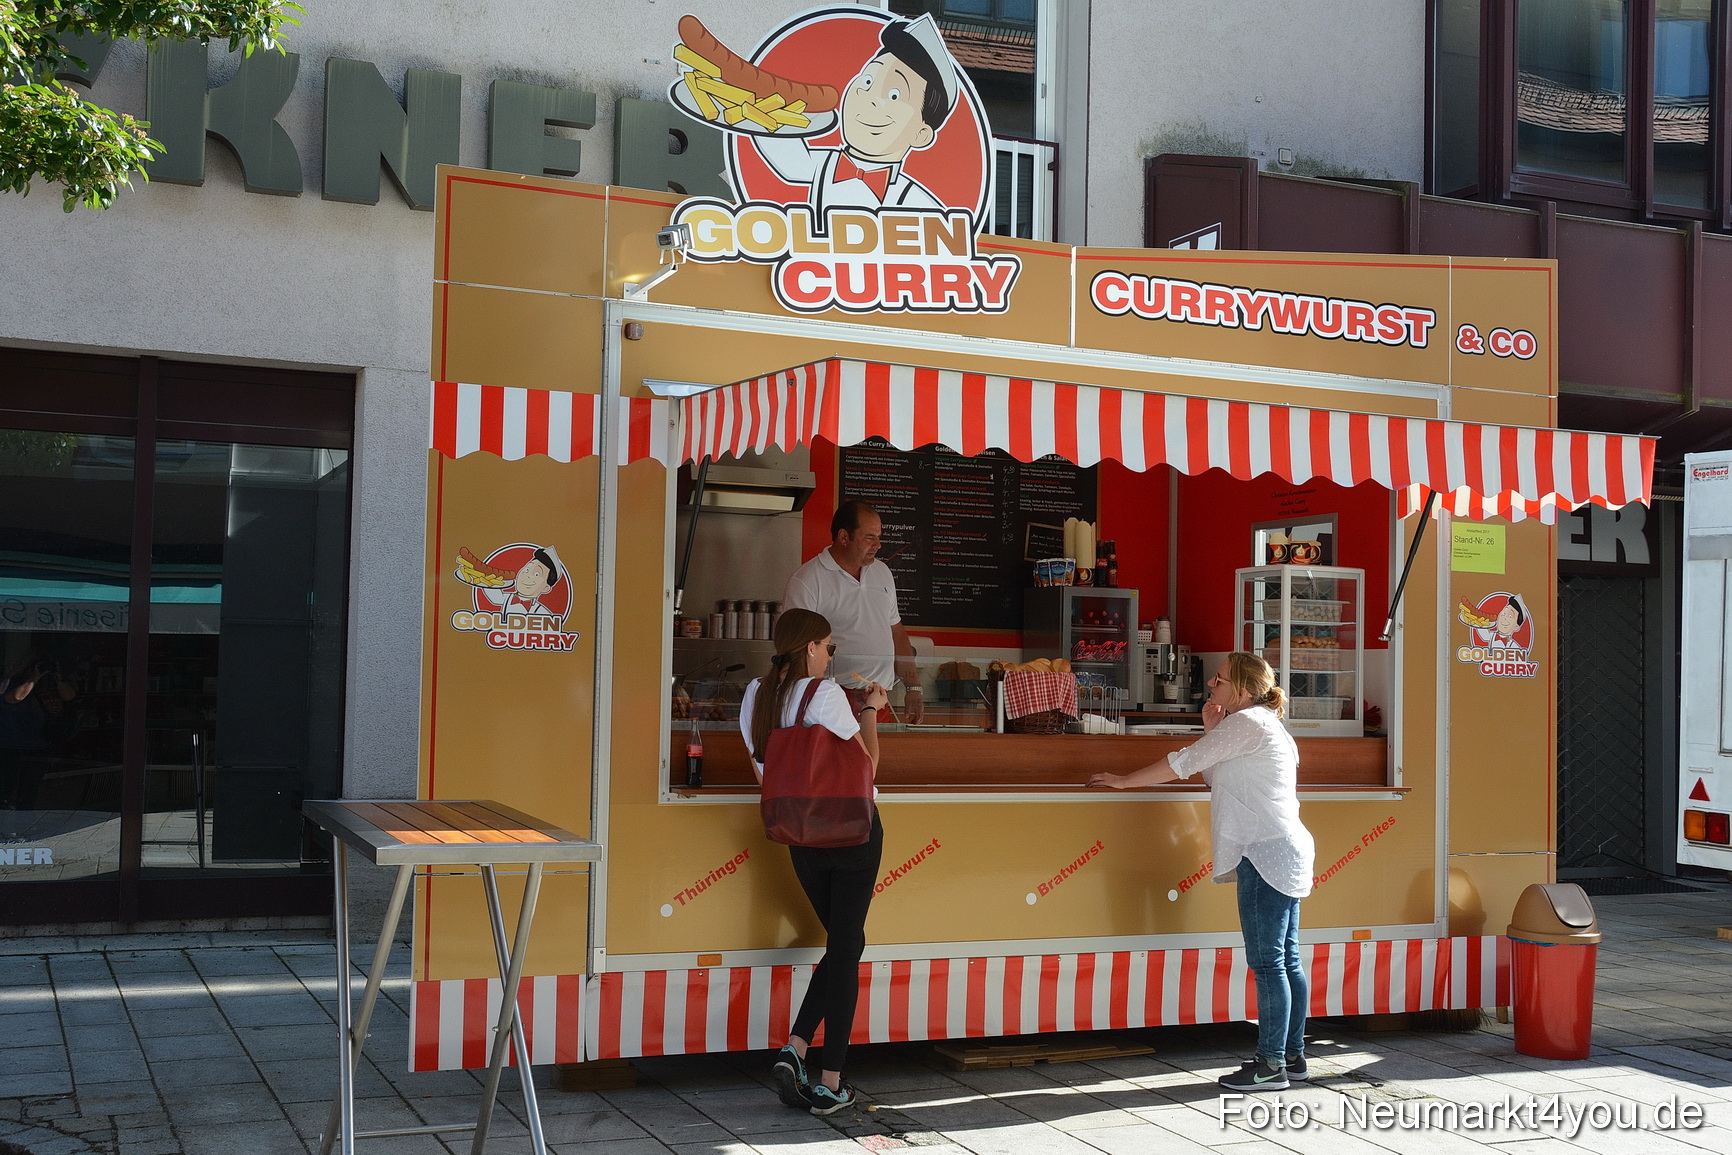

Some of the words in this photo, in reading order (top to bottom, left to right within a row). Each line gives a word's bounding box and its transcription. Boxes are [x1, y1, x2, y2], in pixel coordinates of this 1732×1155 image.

[684, 209, 966, 258] GOLDEN
[782, 261, 1013, 304] CURRY
[1094, 276, 1435, 346] CURRYWURST
[1457, 327, 1482, 352] &
[1491, 330, 1535, 356] CO
[1693, 468, 1729, 478] Engelhard
[881, 522, 916, 532] urrypulver
[1557, 500, 1651, 565] ER
[1454, 535, 1484, 545] Stand-Nr.
[1486, 537, 1494, 546] 26
[452, 612, 560, 632] GOLDEN
[488, 631, 578, 650] CURRY
[1458, 648, 1526, 662] GOLDEN
[1481, 662, 1536, 676] CURRY
[0, 848, 54, 865] NER
[1312, 845, 1362, 889] Pommes
[1361, 816, 1396, 847] Frites
[673, 848, 750, 906] Thüringer
[1037, 840, 1104, 897] Bratwurst
